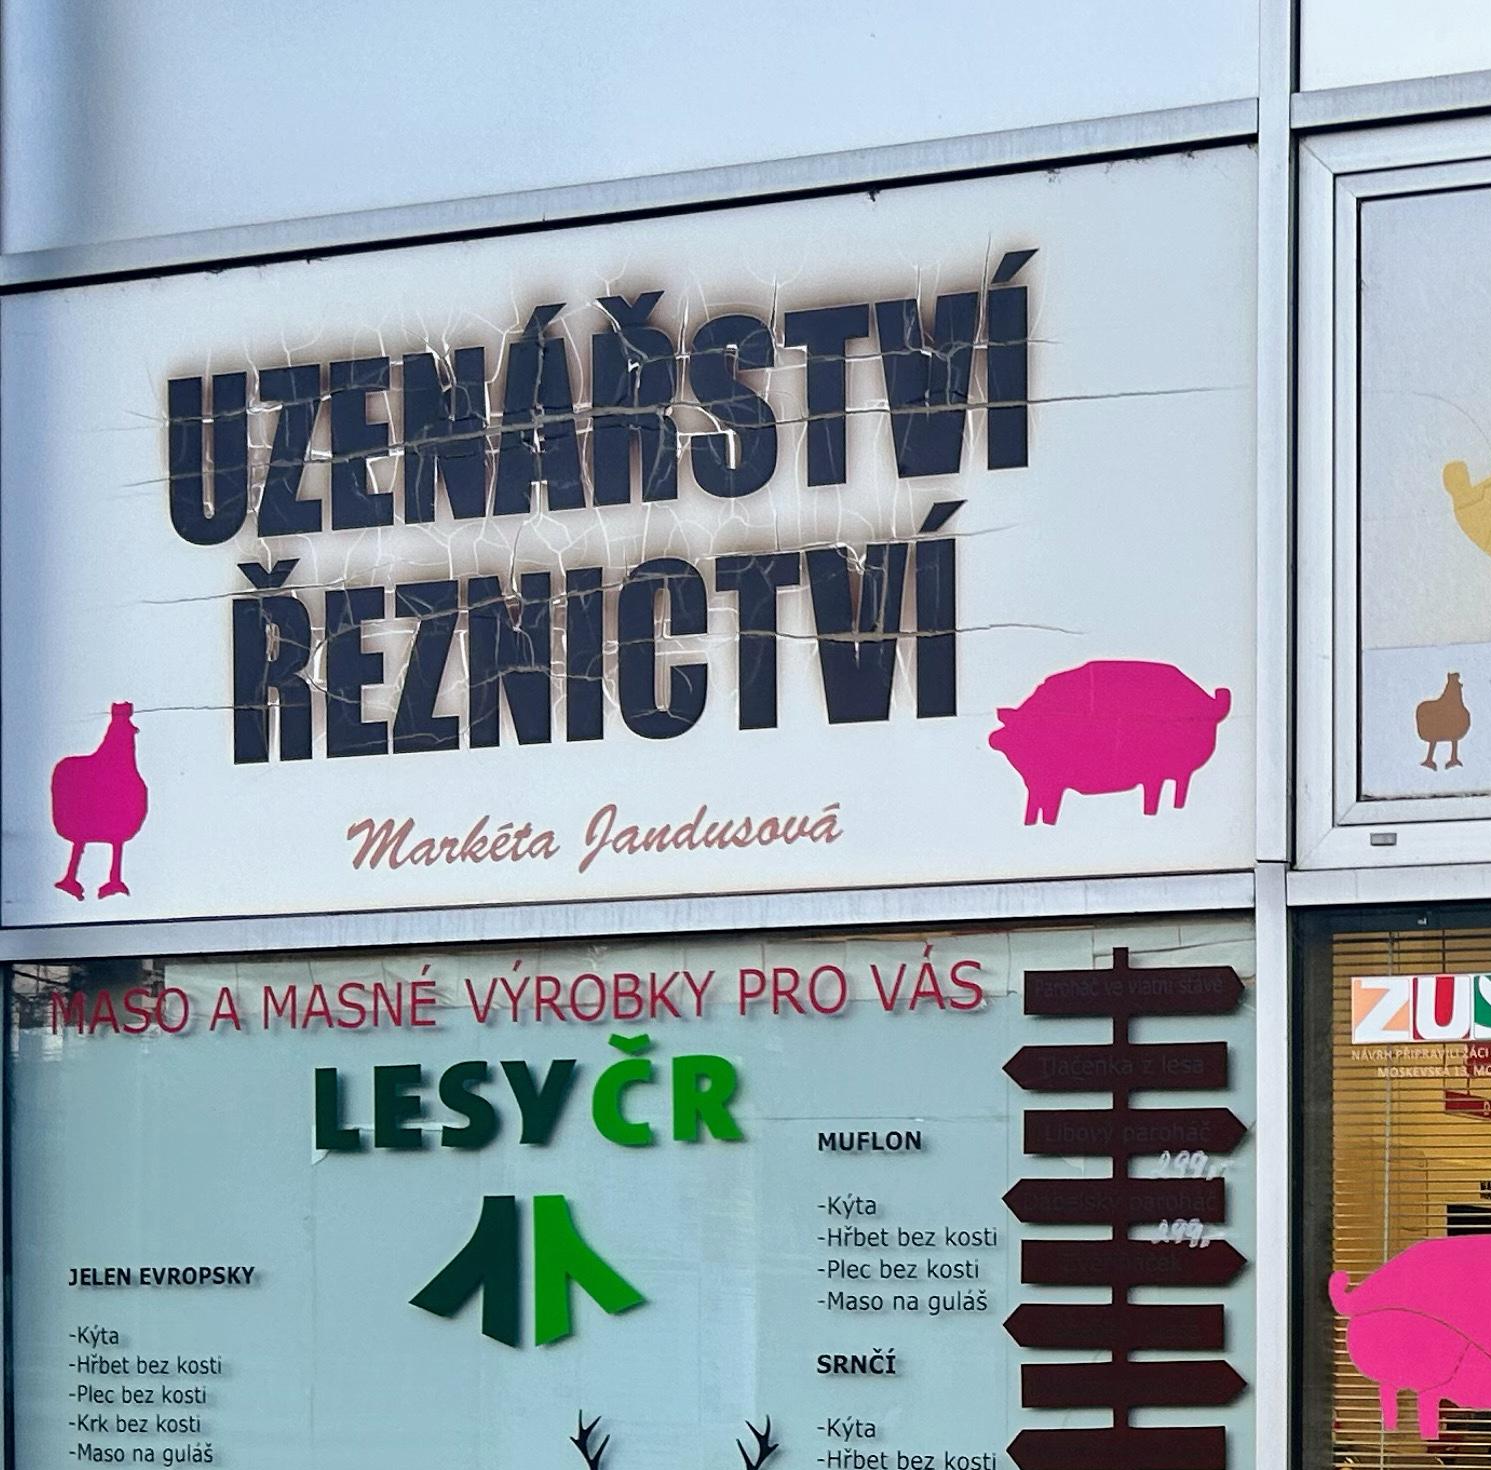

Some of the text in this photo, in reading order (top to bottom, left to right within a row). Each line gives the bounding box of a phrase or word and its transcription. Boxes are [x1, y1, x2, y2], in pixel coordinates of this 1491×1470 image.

[167, 248, 1040, 547] UZENÁŘSTVÍ
[232, 498, 968, 765] ŘEZNICTVÍ
[346, 802, 845, 874] Markéta Jandusová
[52, 944, 984, 1034] MASO A MASNÉ VÝROBKY PRO VÁS
[818, 1130, 922, 1151] MUFLON
[818, 1193, 877, 1220] -Kýta
[818, 1225, 998, 1247] -Hřbet bez kosti
[68, 1266, 255, 1286] JELEN EVROPSKY
[818, 1258, 979, 1279] -Plec bez kosti
[818, 1289, 988, 1316] -Maso na guláš
[69, 1325, 120, 1349] -Kýta
[69, 1353, 222, 1375] -Hřbet bez kosti
[817, 1348, 897, 1375] SRNČÍ
[69, 1385, 207, 1404] -Plec bez kosti
[69, 1414, 201, 1433] -Krk bez kosti
[817, 1416, 876, 1443] -Kýta
[69, 1443, 214, 1467] -Maso na guláš
[817, 1449, 889, 1470] -Hřbet
[897, 1451, 935, 1470] bez
